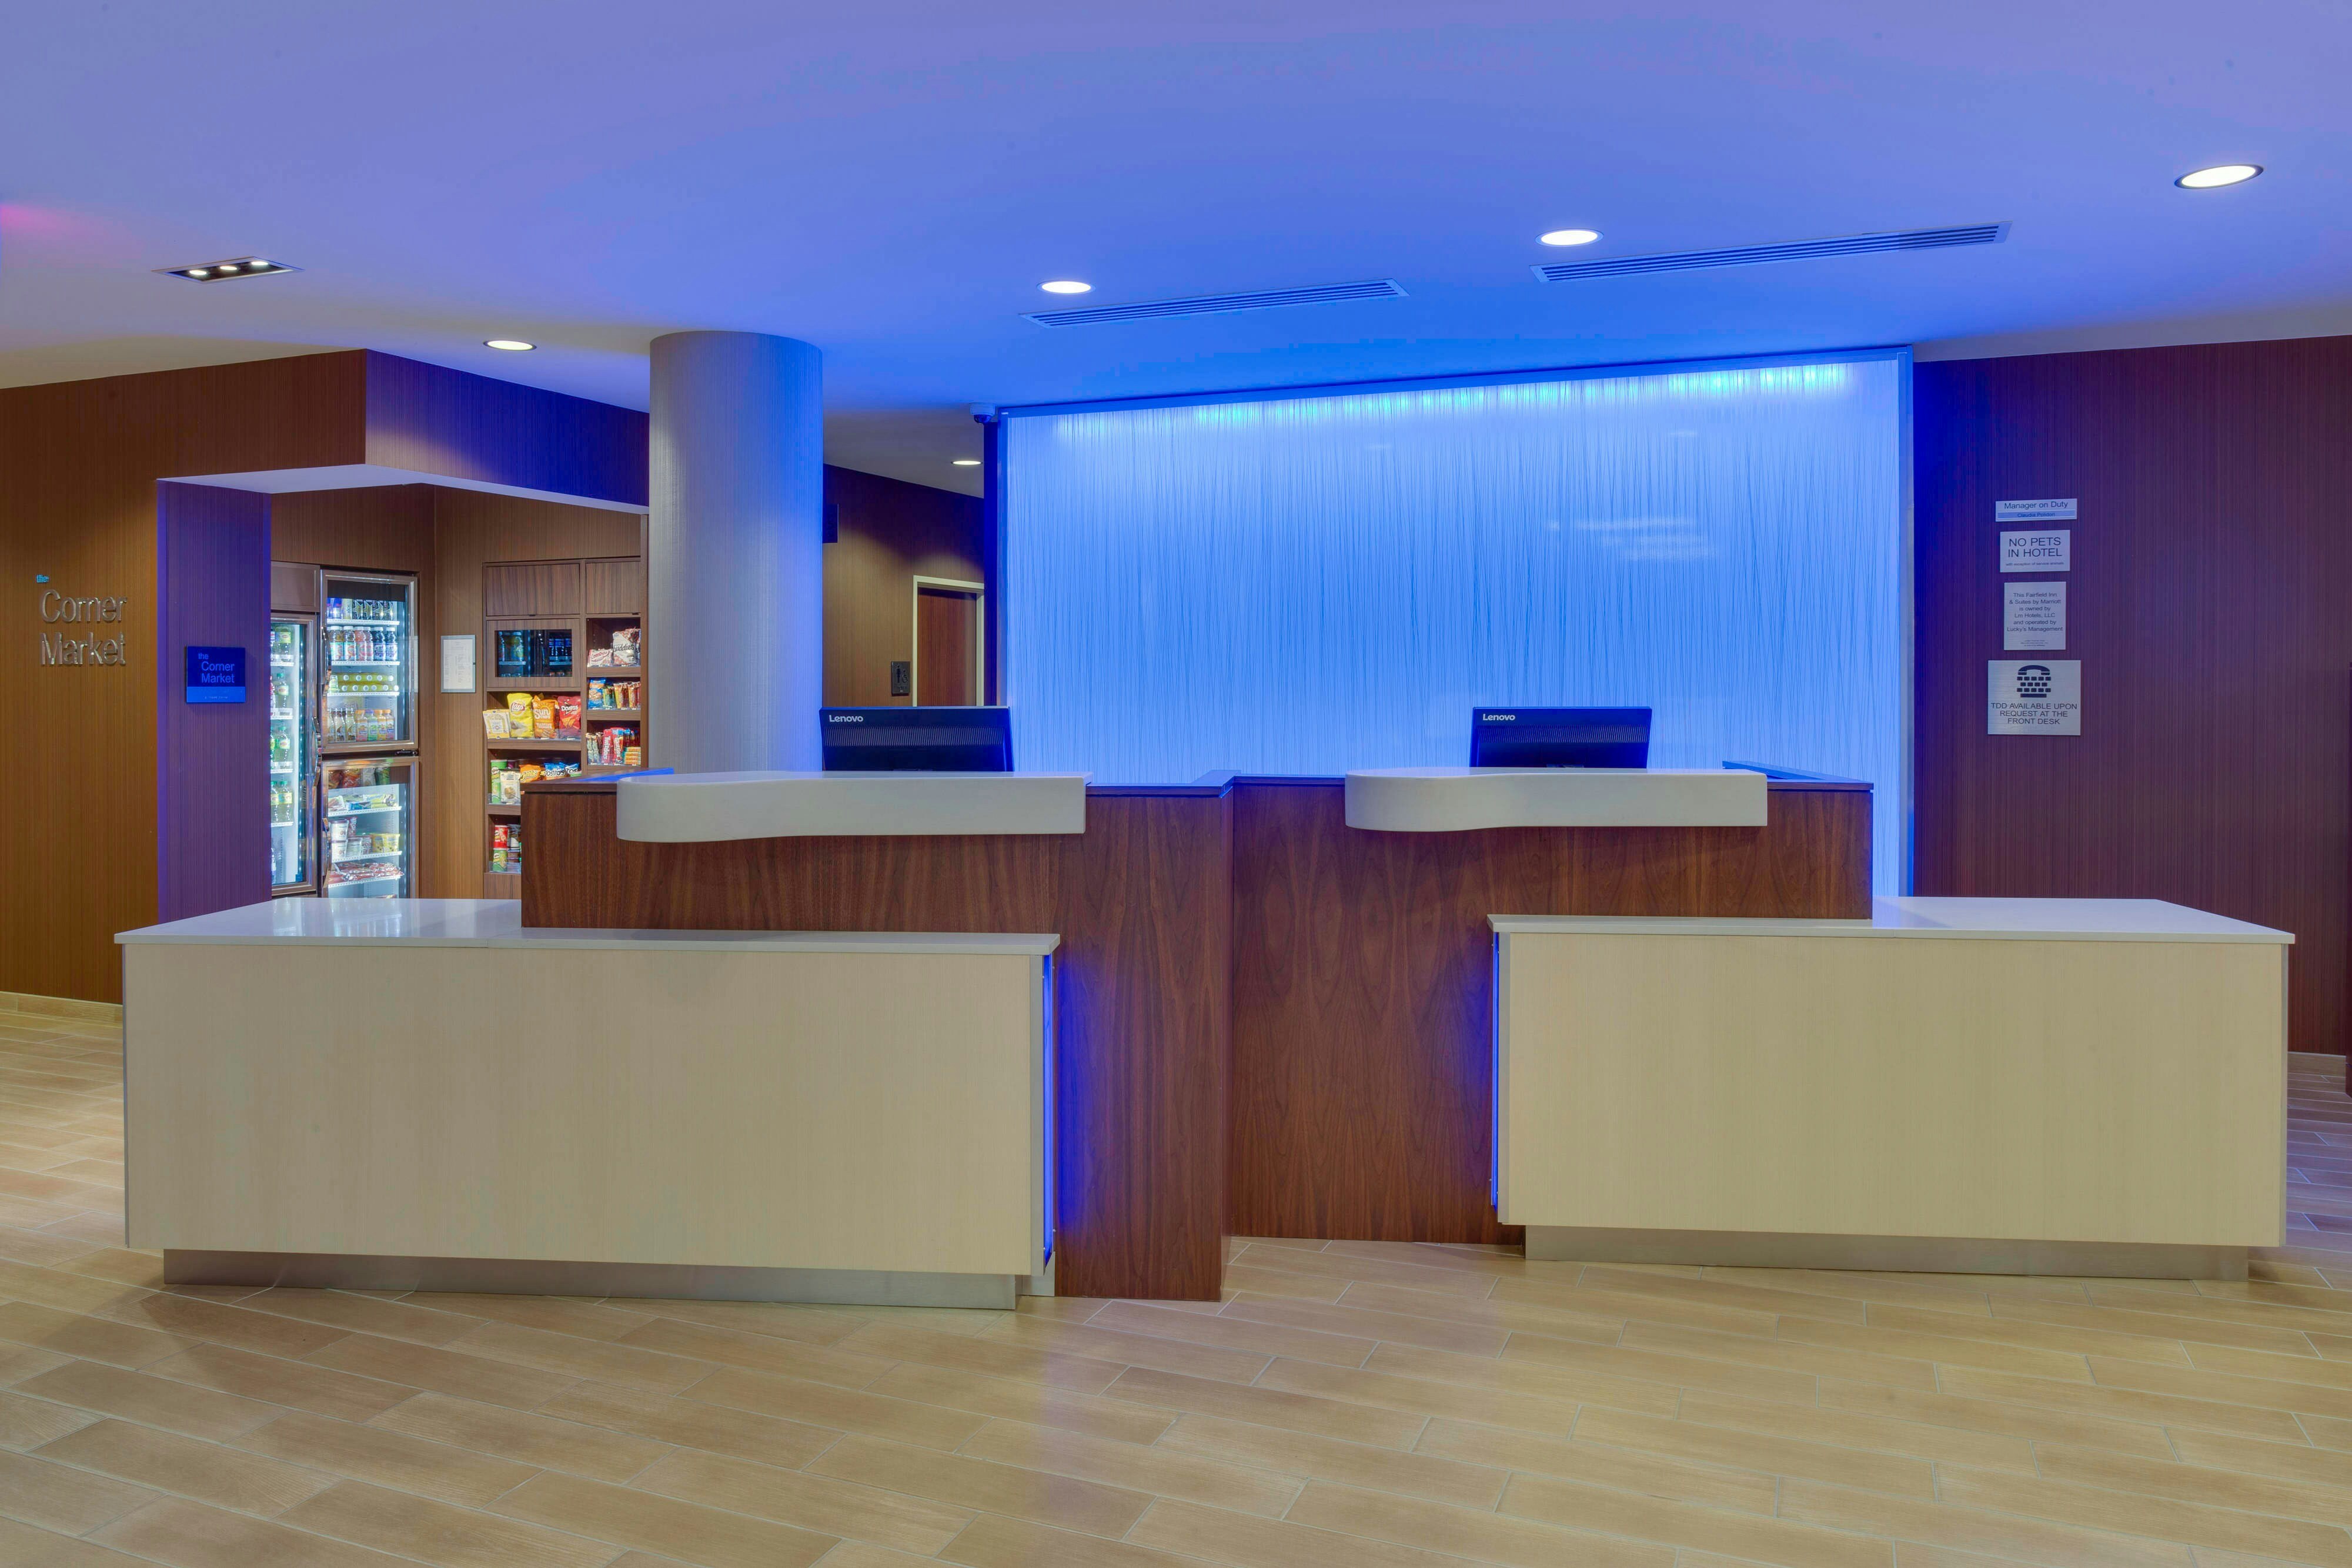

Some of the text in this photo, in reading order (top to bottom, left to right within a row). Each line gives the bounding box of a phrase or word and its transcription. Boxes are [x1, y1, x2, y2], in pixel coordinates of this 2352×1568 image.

[2009, 537, 2061, 547] NO PETS
[2008, 548, 2063, 557] IN HOTEL
[39, 589, 128, 623] Corner
[39, 631, 126, 665] Market
[201, 661, 235, 671] Corner
[201, 673, 235, 683] Market
[828, 714, 864, 723] Lenovo
[1482, 713, 1516, 721] Lenovo
